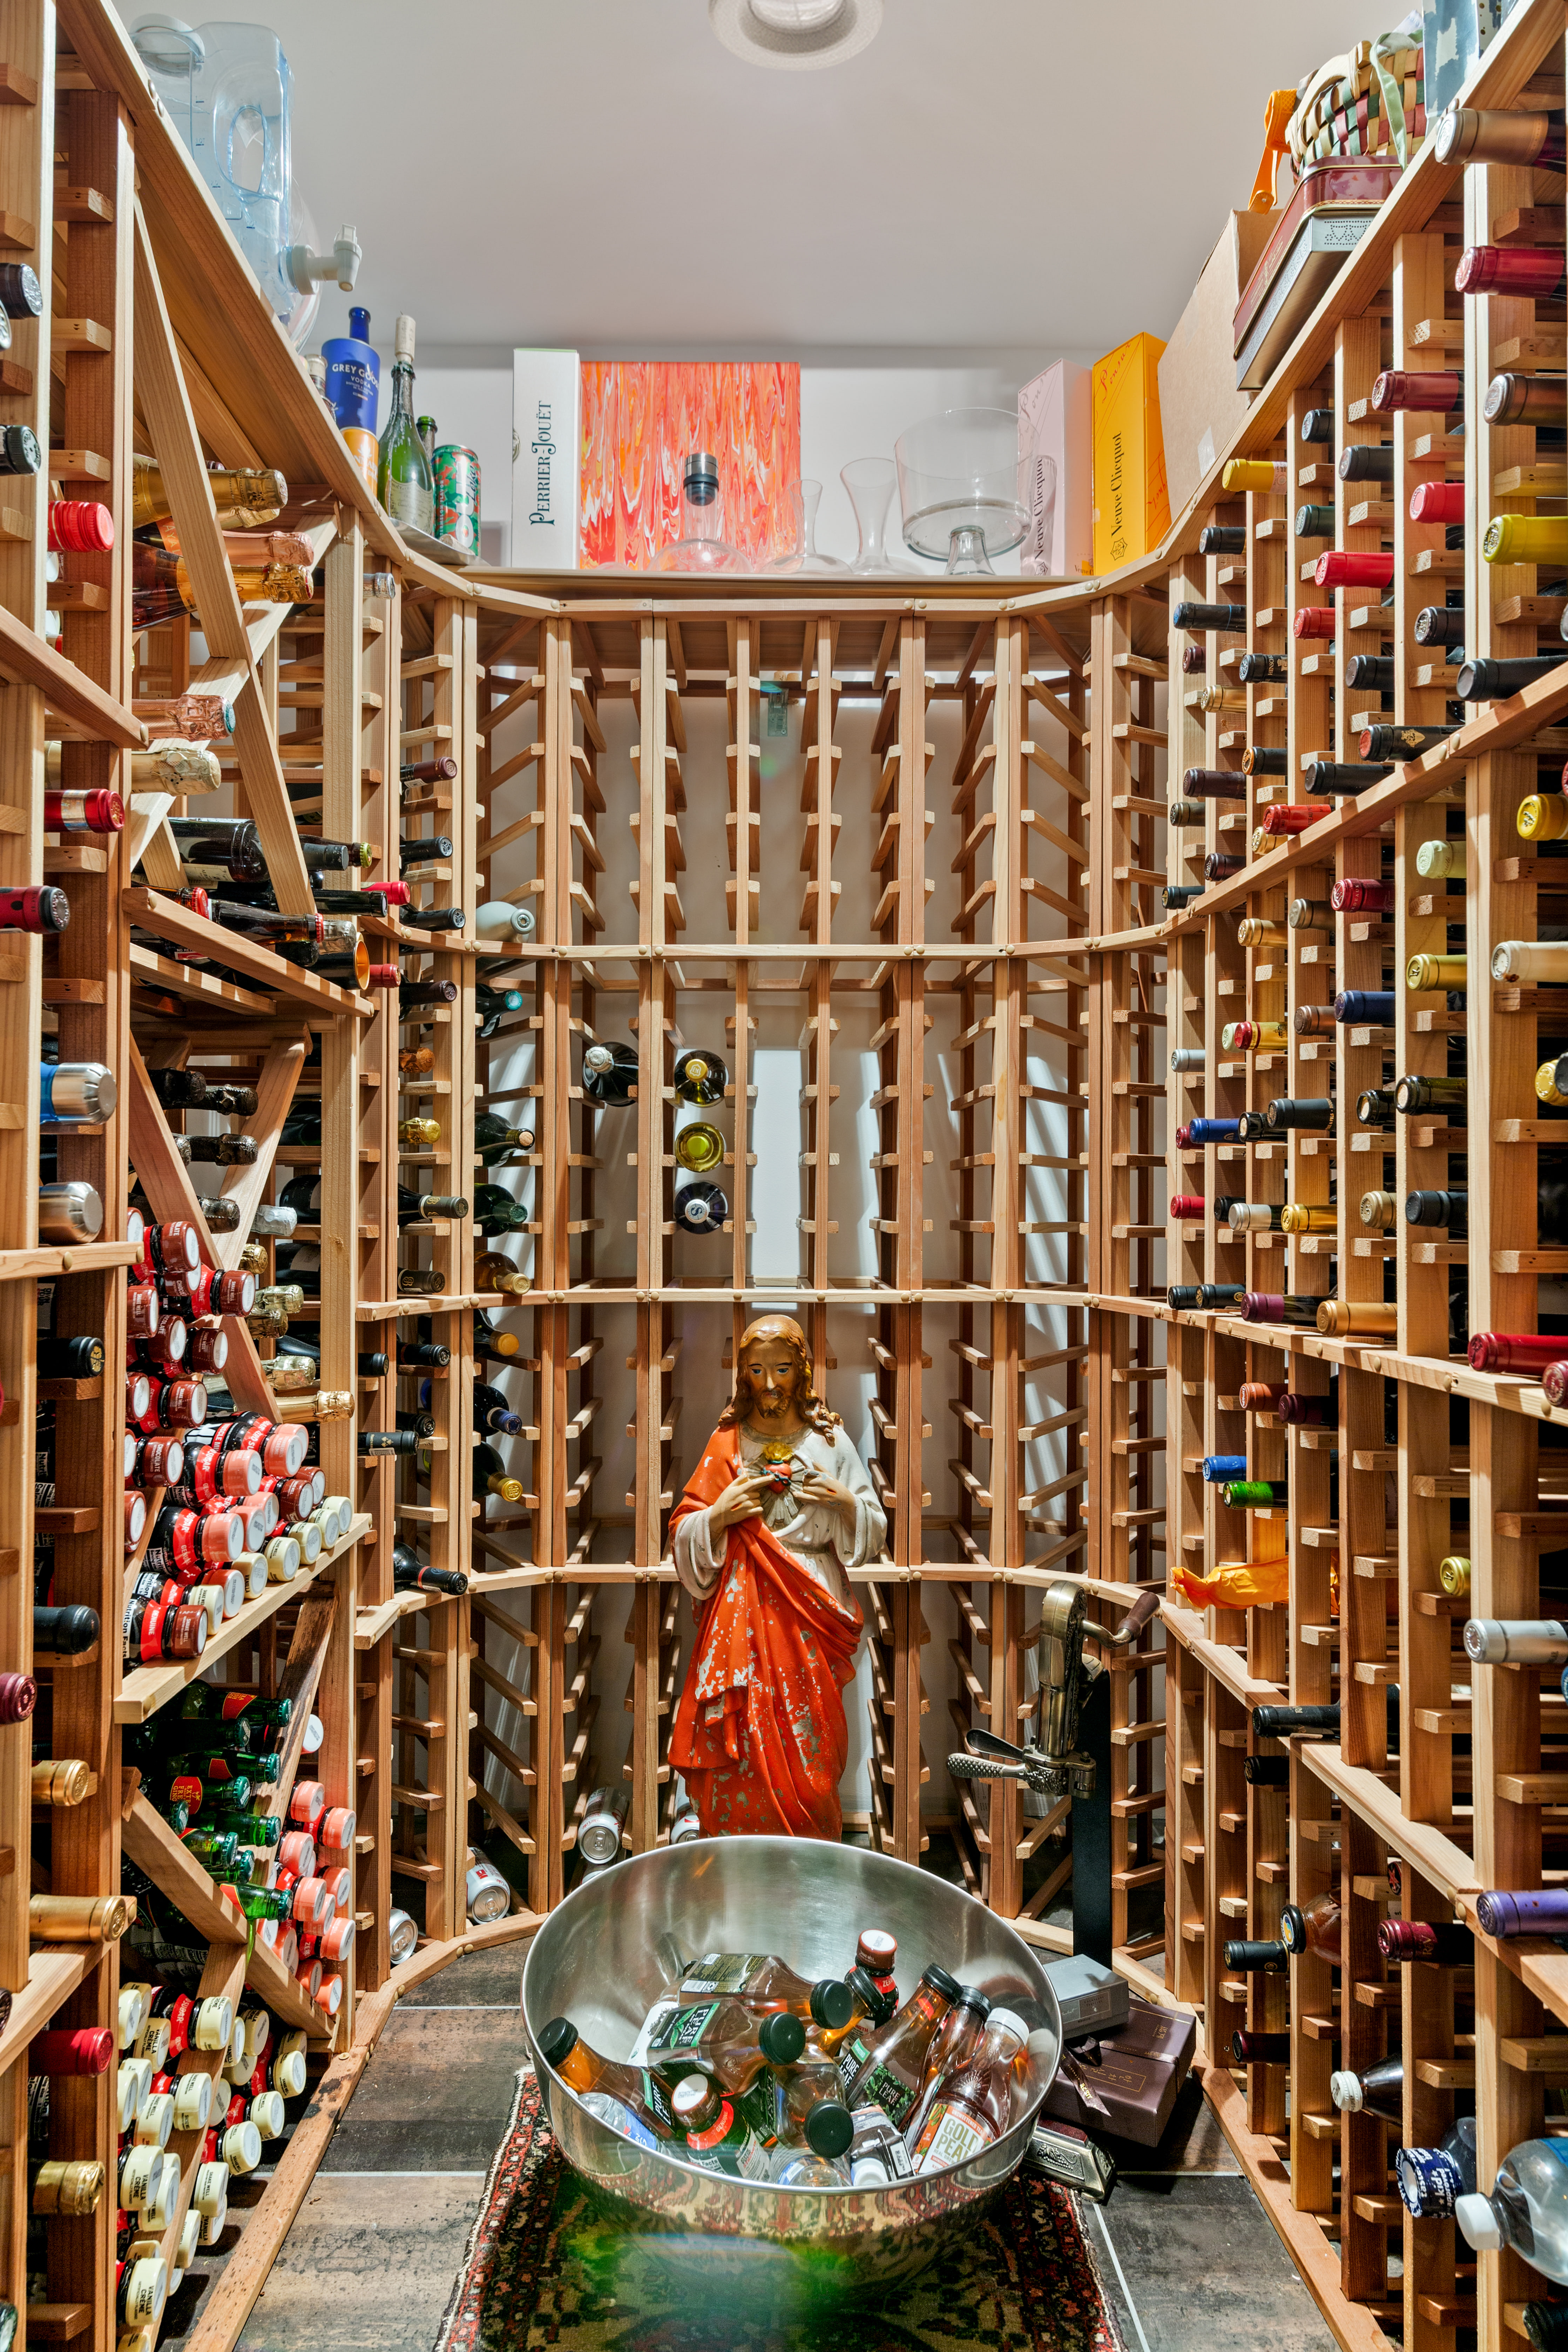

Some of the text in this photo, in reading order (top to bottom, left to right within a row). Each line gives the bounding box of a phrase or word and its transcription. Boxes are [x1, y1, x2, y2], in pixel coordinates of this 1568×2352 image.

[332, 364, 357, 374] GREY
[351, 376, 371, 389] VODKA
[466, 465, 477, 505] Loko
[1111, 431, 1124, 538] Veuve Clicquot
[1034, 518, 1043, 560] Veuve
[199, 1279, 207, 1301] GENUINE
[154, 1444, 163, 1472] CHOCOLATE
[123, 1600, 135, 1633] Nutrition
[148, 1610, 160, 1635] GENUINE
[176, 2000, 190, 2023] SUGAR
[682, 2009, 703, 2045] LEAF
[688, 2008, 709, 2043] PURE
[146, 2030, 155, 2052] CRÈME
[151, 2028, 162, 2054] VANILLA
[843, 2053, 860, 2077] PURE
[652, 2081, 663, 2116] PURE
[878, 2088, 897, 2106] LEAF
[882, 2081, 900, 2100] PURE
[716, 2110, 729, 2133] GENUINE
[951, 2110, 977, 2129] UNSWEETENED
[944, 2118, 979, 2154] GOLD
[933, 2149, 943, 2157] REAL
[140, 2174, 149, 2201] VANILLA
[1431, 2177, 1445, 2196] kid
[138, 2289, 147, 2314] CRÈME
[146, 2285, 155, 2316] VANILLA
